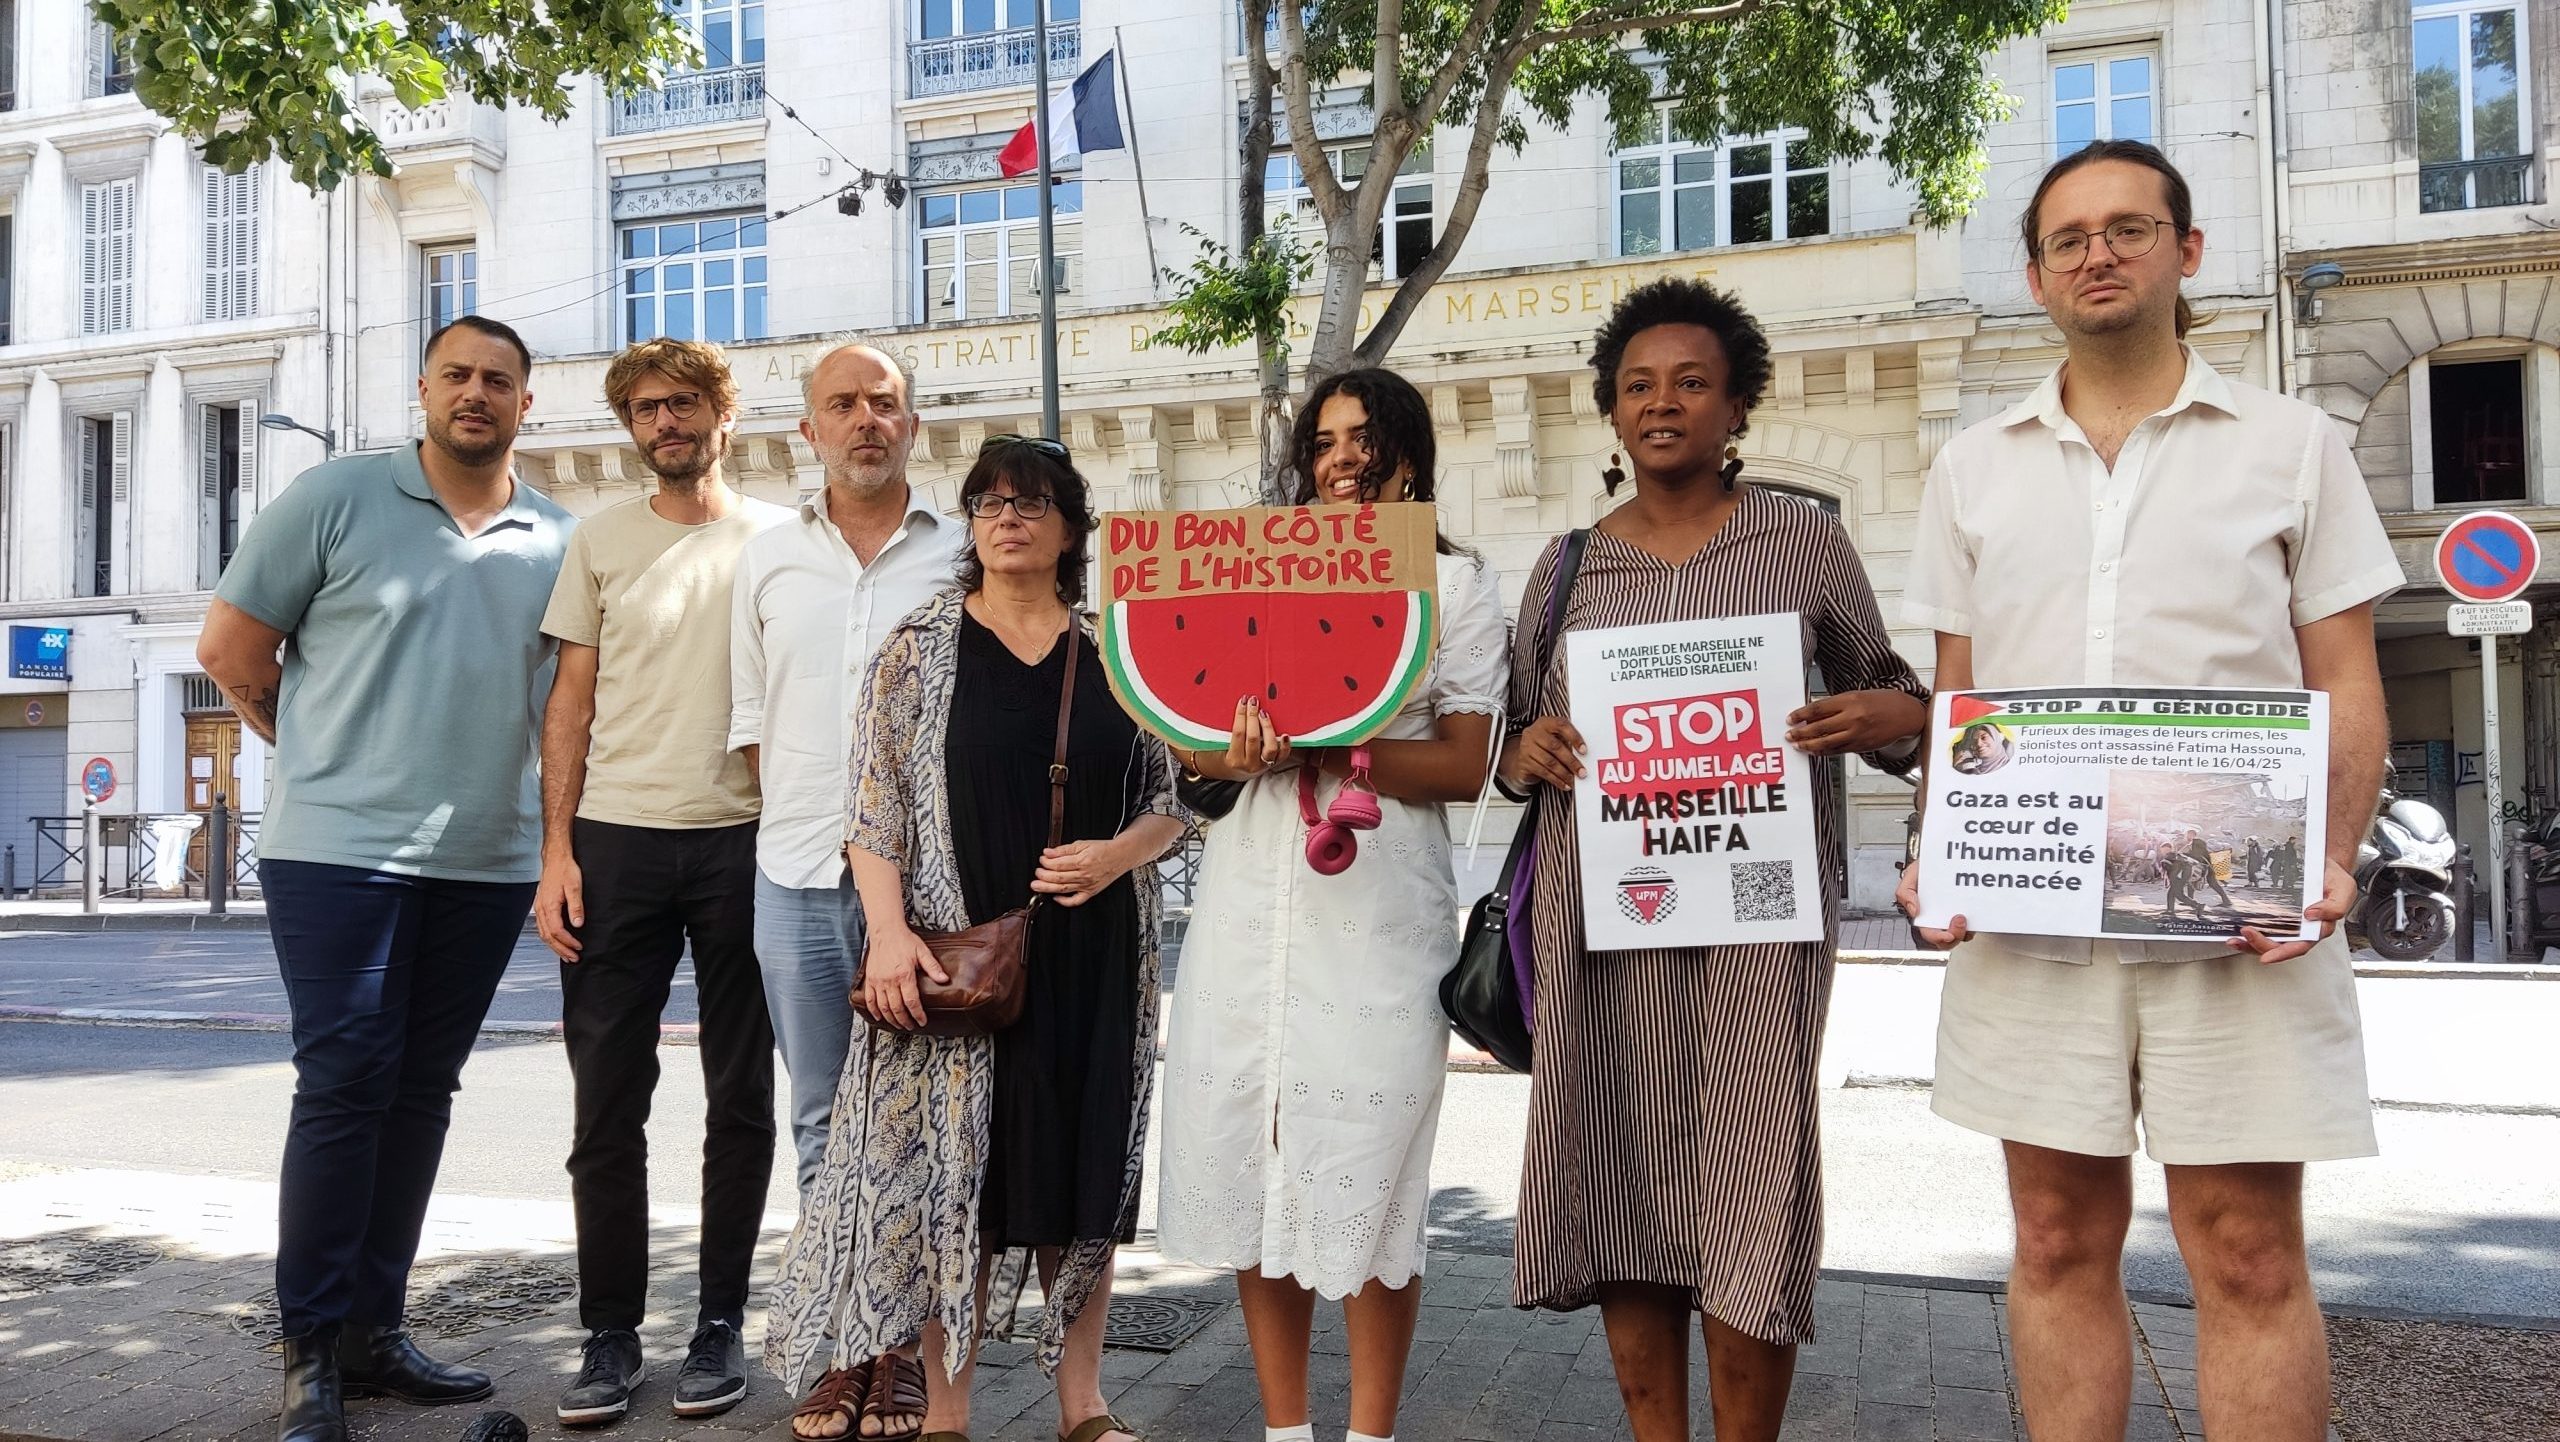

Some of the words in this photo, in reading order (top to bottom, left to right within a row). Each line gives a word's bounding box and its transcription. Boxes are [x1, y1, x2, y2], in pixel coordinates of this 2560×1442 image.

[1110, 517, 1159, 555] DU
[1174, 513, 1246, 550] BON
[1263, 502, 1378, 546] CÔTÉ
[1113, 557, 1160, 599] DE
[1601, 649, 1616, 660] LA
[1618, 645, 1659, 658] MAIRIE
[1662, 643, 1677, 654] DE
[1680, 638, 1747, 653] MARSEILLE
[1748, 636, 1765, 647] NE
[19, 663, 64, 671] BANQUE
[1620, 658, 1649, 669] DOIT
[1651, 655, 1682, 667] PLUS
[1684, 650, 1746, 664] SOUTENIR
[19, 670, 64, 678] POPULAIRE
[1611, 667, 1688, 682] L'APARTHEID
[1754, 661, 1758, 671] !
[2008, 700, 2082, 714] STOP
[2097, 700, 2138, 713] AU
[2153, 699, 2309, 717] GÉNOCIDE
[1622, 697, 1754, 753] STOP
[2021, 726, 2069, 736] Furieux
[2072, 726, 2096, 736] des
[2099, 726, 2149, 738] images
[2152, 727, 2170, 738] de
[2173, 727, 2208, 739] leurs
[2211, 729, 2264, 741] crimes,
[2267, 730, 2288, 741] les
[2020, 740, 2077, 750] sionistes
[2080, 740, 2103, 750] ont
[2106, 741, 2174, 752] assassiné
[2178, 742, 2227, 753] Fatima
[2231, 743, 2306, 757] Hassouna,
[1602, 761, 1636, 785] AU
[1641, 751, 1782, 782] JUMELAGE
[2019, 753, 2128, 766] photojournaliste
[2131, 755, 2148, 766] de
[2152, 756, 2196, 768] talent
[2197, 757, 2209, 768] le
[2213, 757, 2282, 769] 16/04/25
[1602, 784, 1787, 822] MARSEILLE
[1946, 791, 2009, 808] Gaza
[2017, 791, 2059, 808] est
[2068, 794, 2103, 810] au
[1964, 820, 2036, 835] cœur
[2043, 816, 2079, 836] de
[1646, 823, 1750, 856] HAIFA
[1946, 841, 2096, 864] l'humanité
[1955, 870, 2082, 891] menacée
